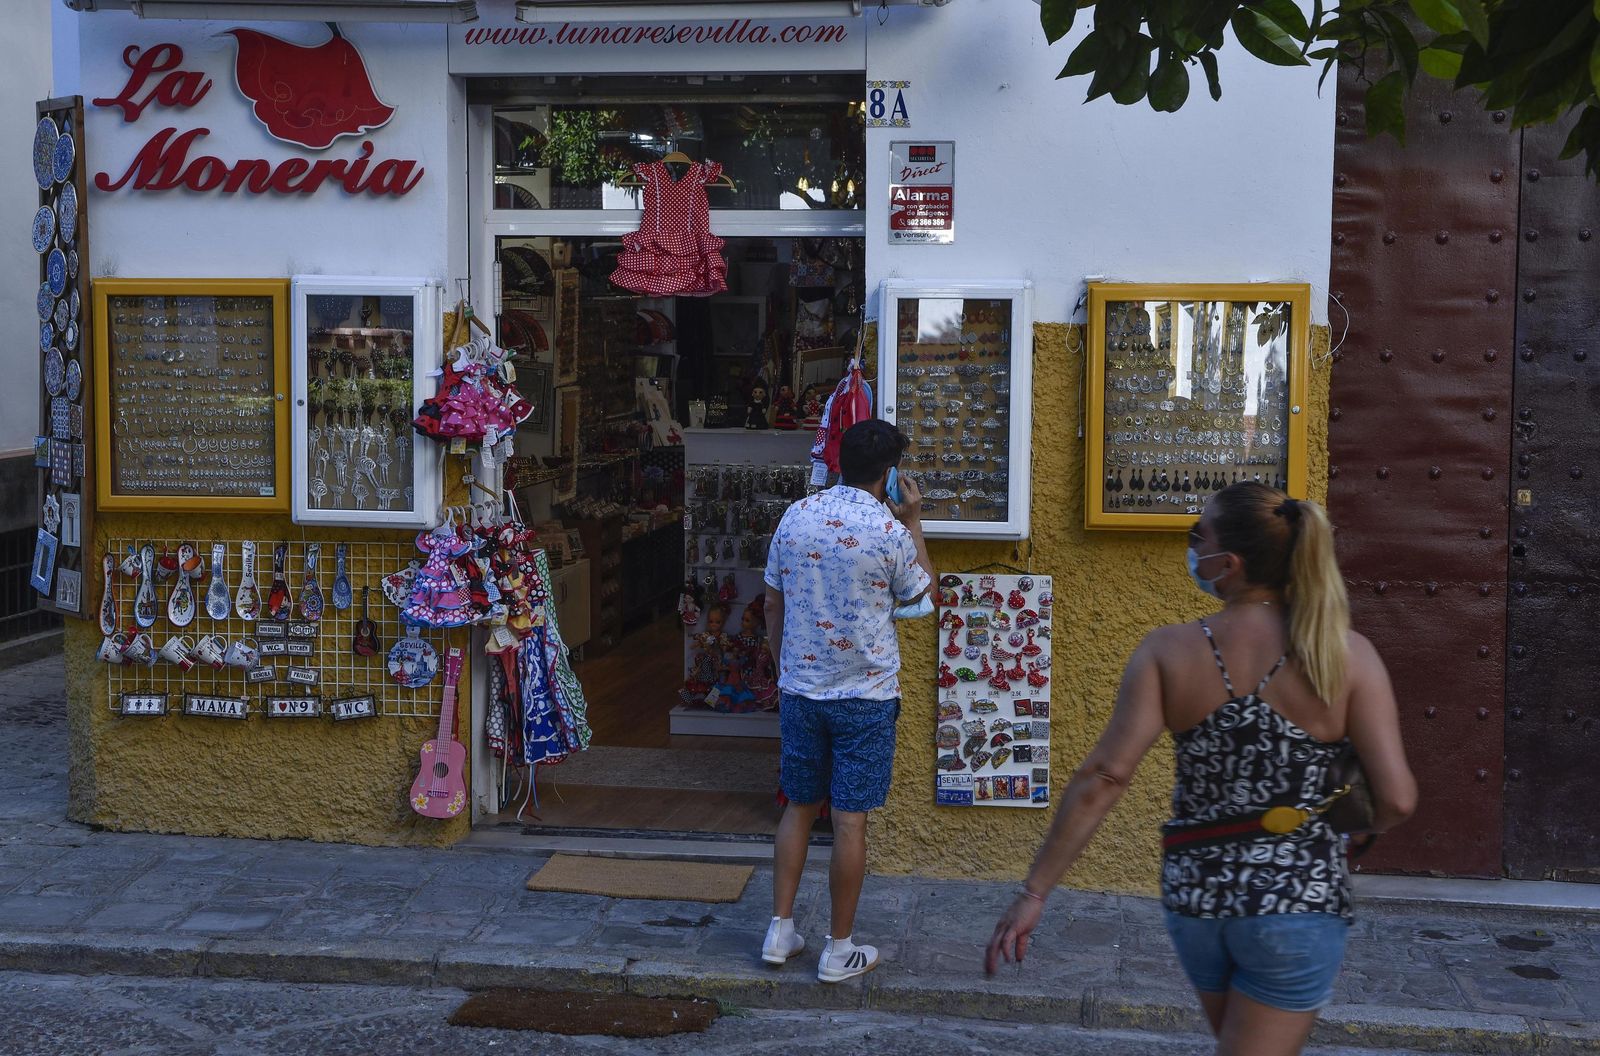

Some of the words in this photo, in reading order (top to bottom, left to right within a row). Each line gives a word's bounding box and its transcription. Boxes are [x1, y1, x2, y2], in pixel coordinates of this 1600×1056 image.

[92, 43, 213, 122] La
[869, 88, 886, 119] 8
[890, 88, 909, 120] A
[94, 127, 425, 197] Monería
[900, 161, 947, 182] Direct
[893, 188, 950, 201] Alarma
[918, 203, 949, 211] grabación
[245, 553, 253, 578] Sevilla
[399, 641, 428, 649] SEVILLA
[196, 700, 237, 714] MAMA
[343, 701, 365, 714] WC
[941, 776, 971, 784] SEVILLA
